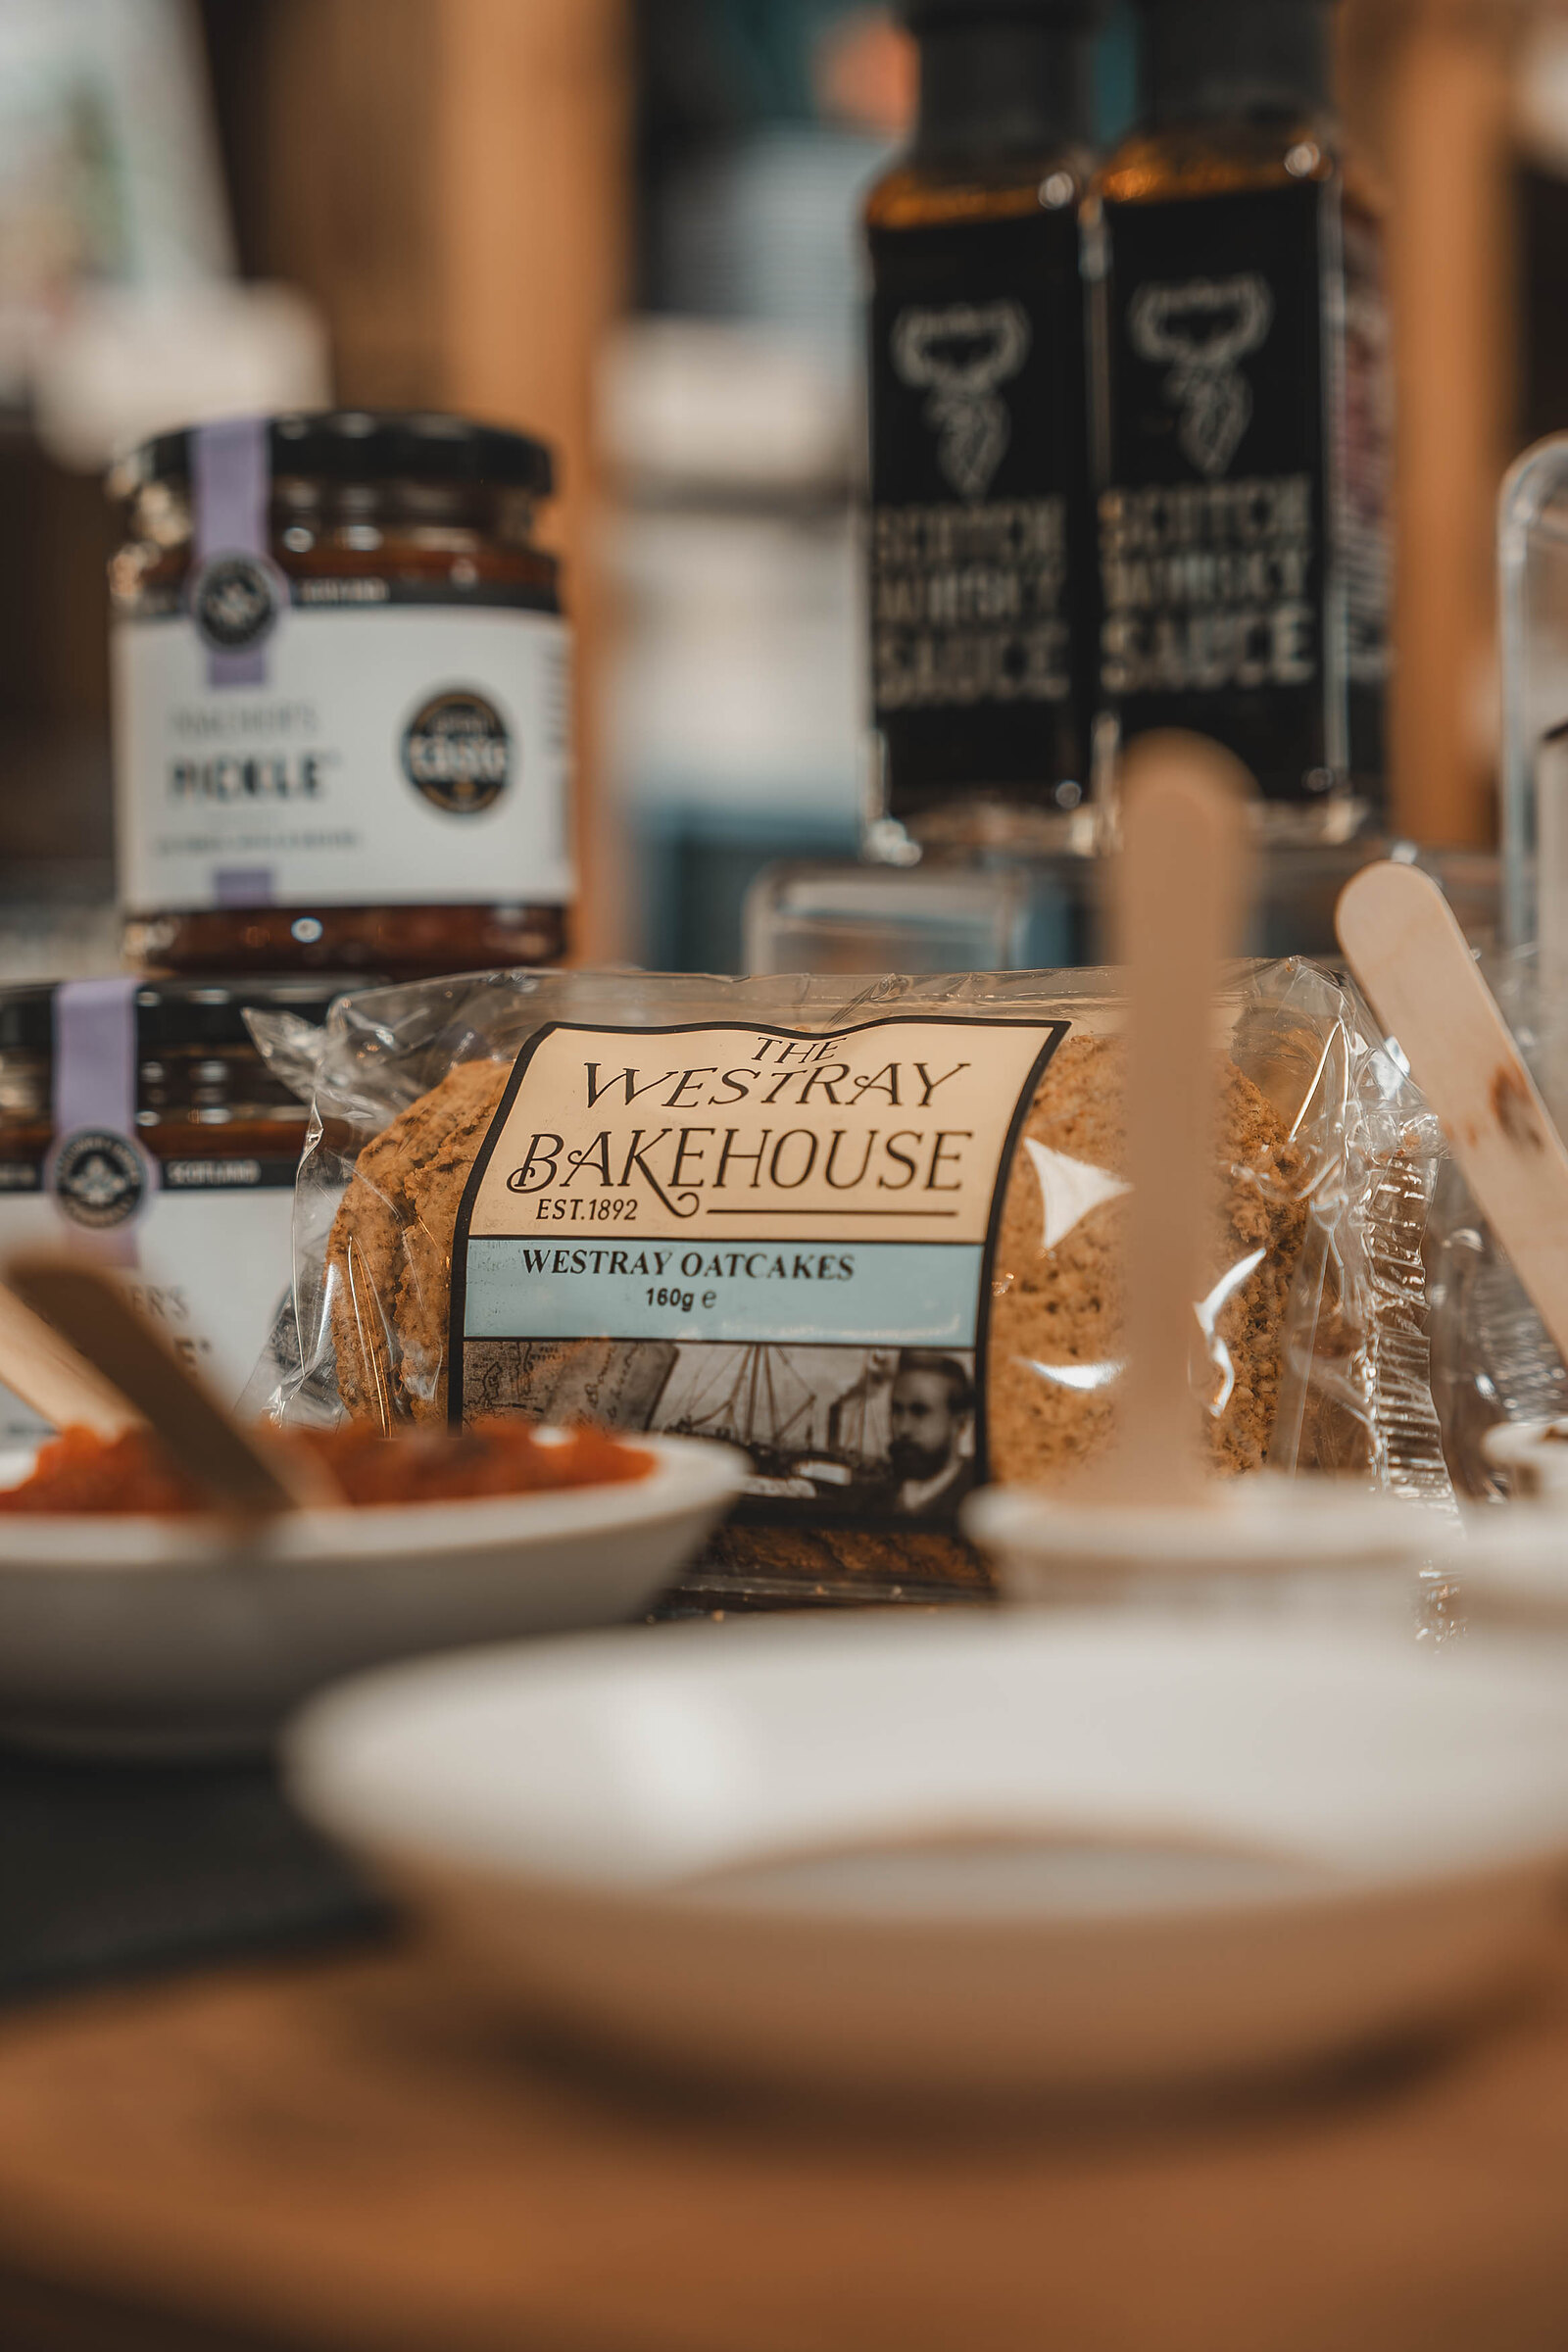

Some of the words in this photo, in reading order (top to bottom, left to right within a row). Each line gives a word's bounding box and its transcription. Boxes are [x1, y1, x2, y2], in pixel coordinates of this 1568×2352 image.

[752, 1036, 848, 1064] THE
[582, 1061, 971, 1108] WESTRAY
[506, 1127, 974, 1218] BAKEHOUSE
[535, 1198, 639, 1221] EST.1892
[521, 1249, 673, 1276] WESTRAY
[680, 1250, 856, 1282] OATCAKES
[645, 1287, 695, 1312] 160g
